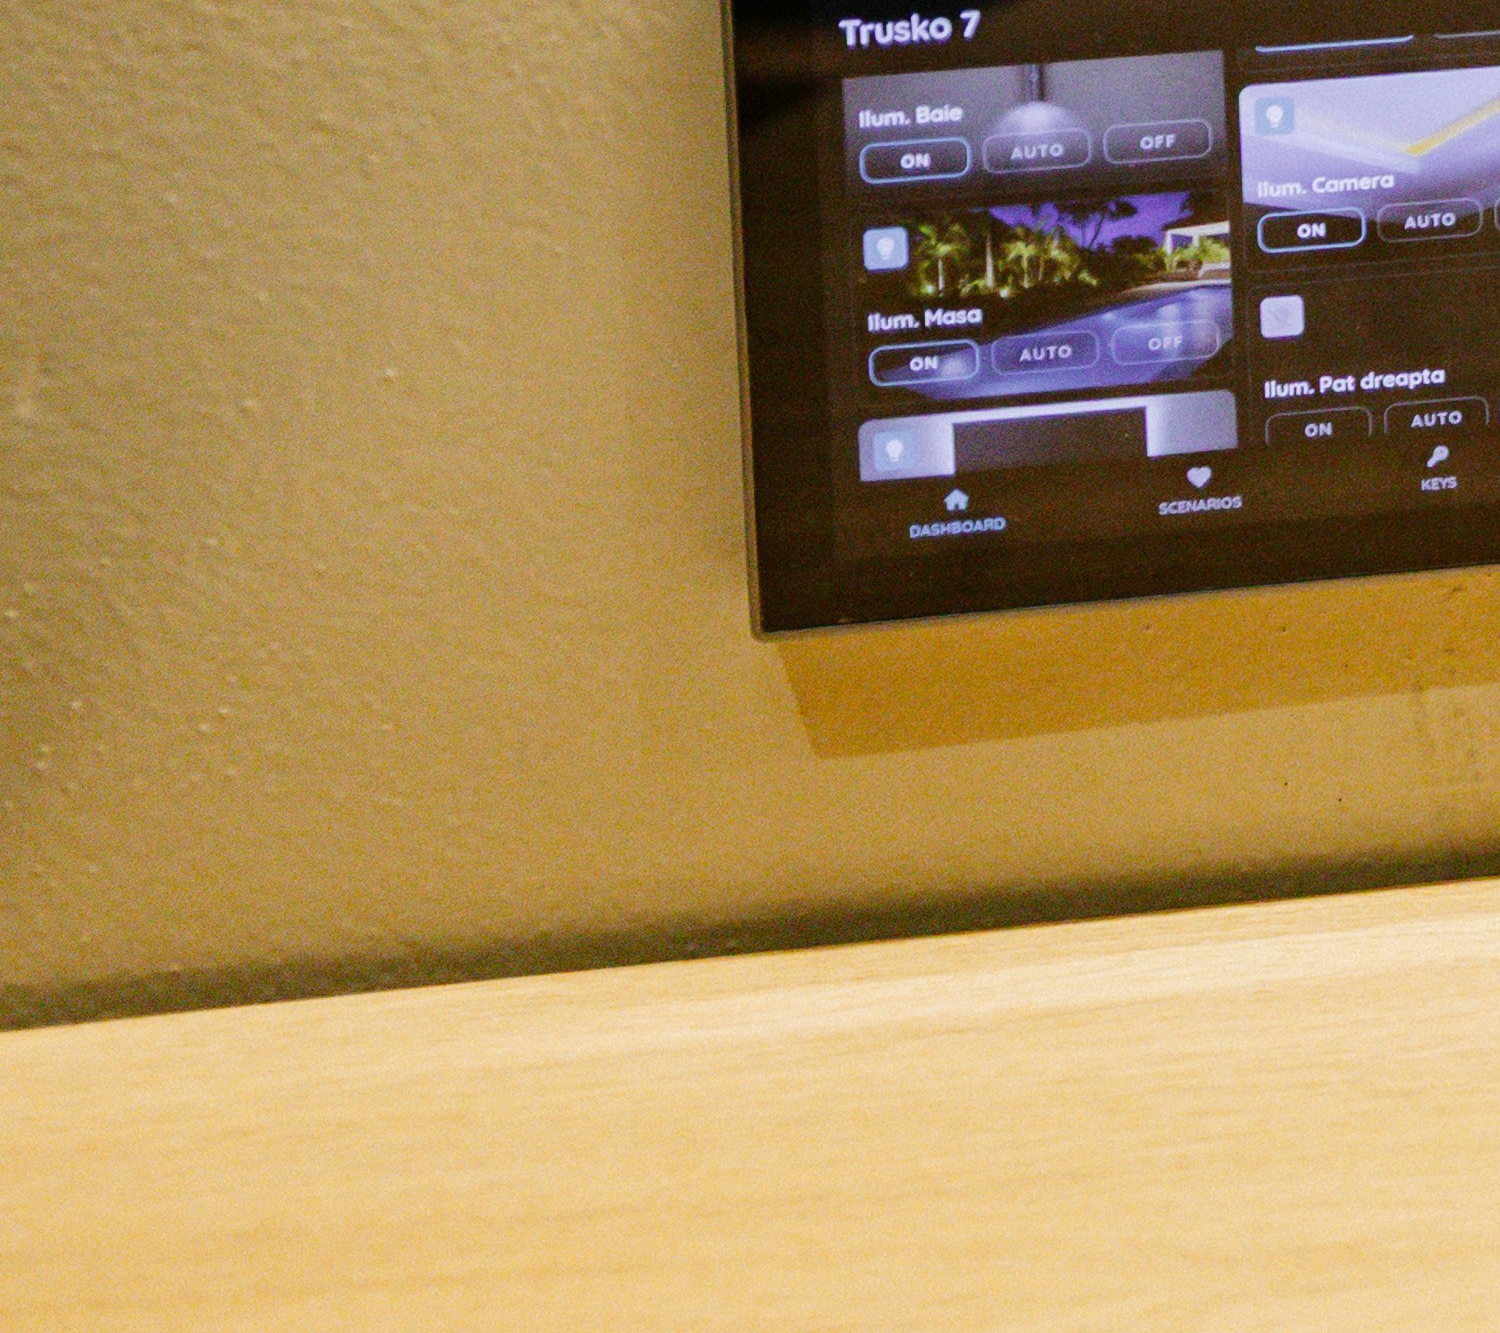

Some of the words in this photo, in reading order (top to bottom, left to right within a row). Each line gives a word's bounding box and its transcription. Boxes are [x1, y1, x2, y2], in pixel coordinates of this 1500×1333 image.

[839, 13, 953, 49] Trusko
[959, 9, 982, 39] 7
[915, 104, 963, 125] Baie
[1010, 142, 1064, 161] AUTO
[1139, 134, 1177, 152] OFF
[900, 152, 931, 170] ON
[1312, 173, 1396, 195] Camera
[1296, 222, 1327, 239] ON
[1404, 212, 1457, 230] AUTO
[925, 307, 983, 328] Masa
[1147, 335, 1184, 352] OFF
[1019, 344, 1073, 363] AUTO
[909, 355, 939, 373] ON
[1319, 374, 1356, 394] Pat
[1360, 368, 1446, 390] dreapta
[1410, 410, 1463, 429] AUTO
[1304, 421, 1333, 439] ON
[1420, 475, 1458, 492] KEYS
[1158, 495, 1243, 515] SCENARIOS
[909, 516, 1006, 539] DASHBOARD
